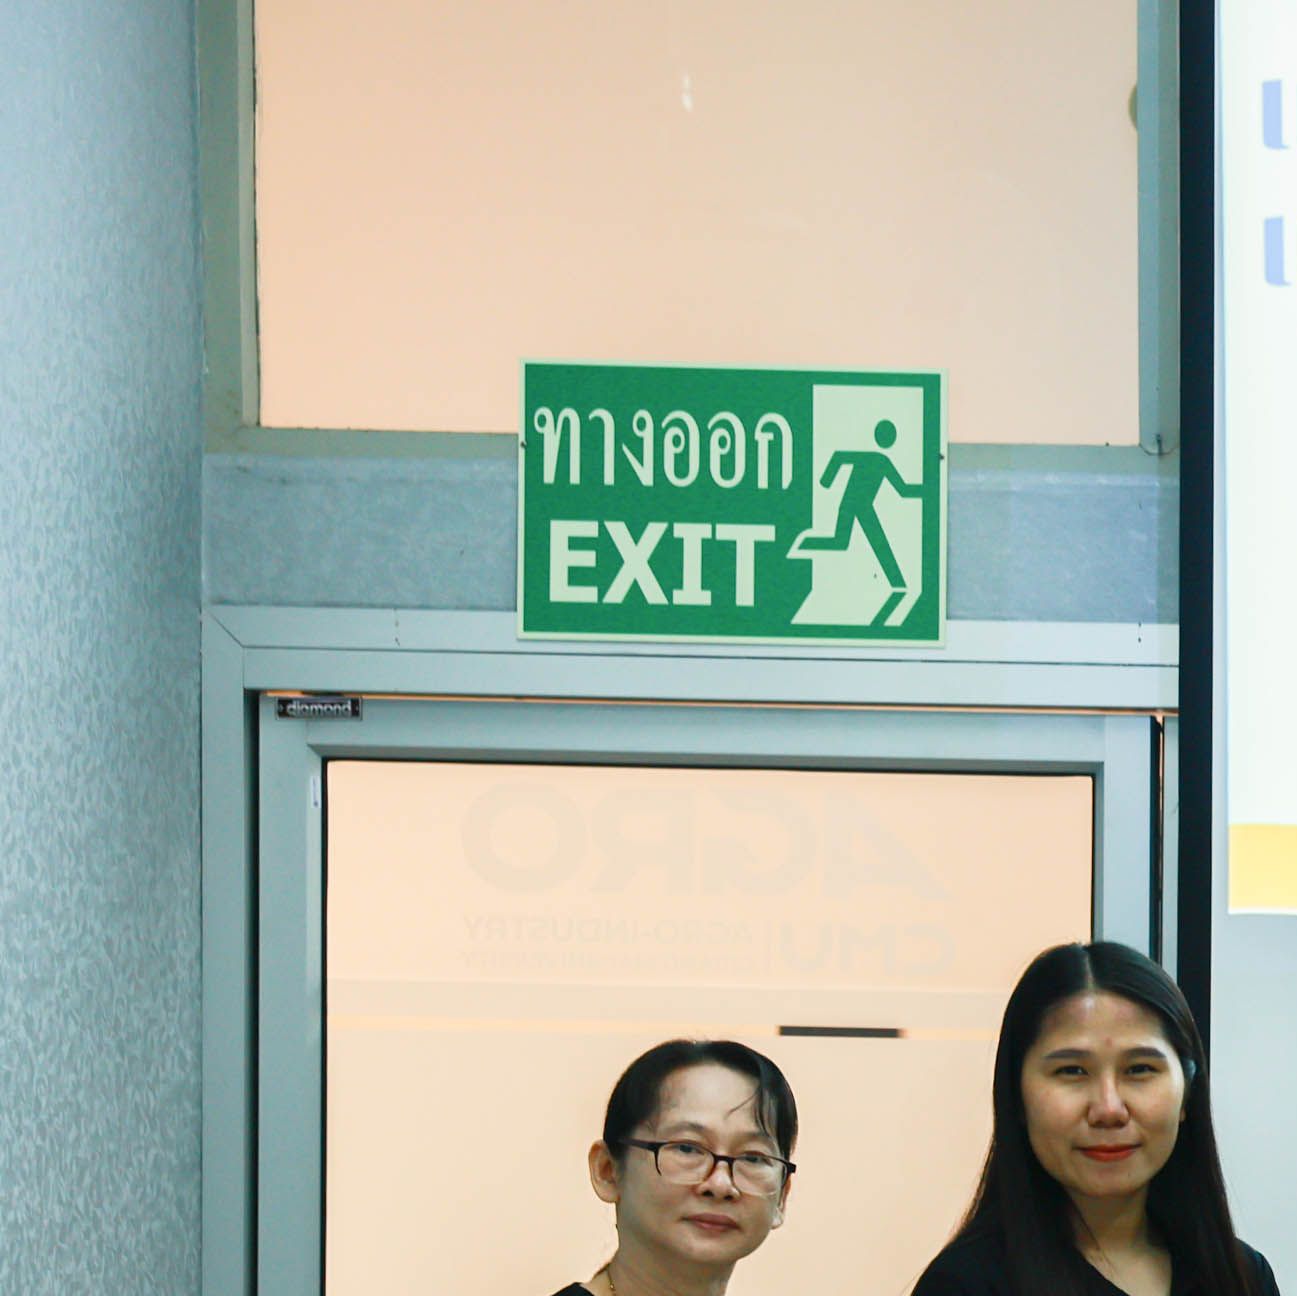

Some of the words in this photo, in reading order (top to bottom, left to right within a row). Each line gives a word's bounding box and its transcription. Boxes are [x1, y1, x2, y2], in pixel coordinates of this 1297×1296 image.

[533, 405, 794, 490] ทางออก
[549, 519, 776, 607] EXIT
[286, 699, 352, 716] diamond
